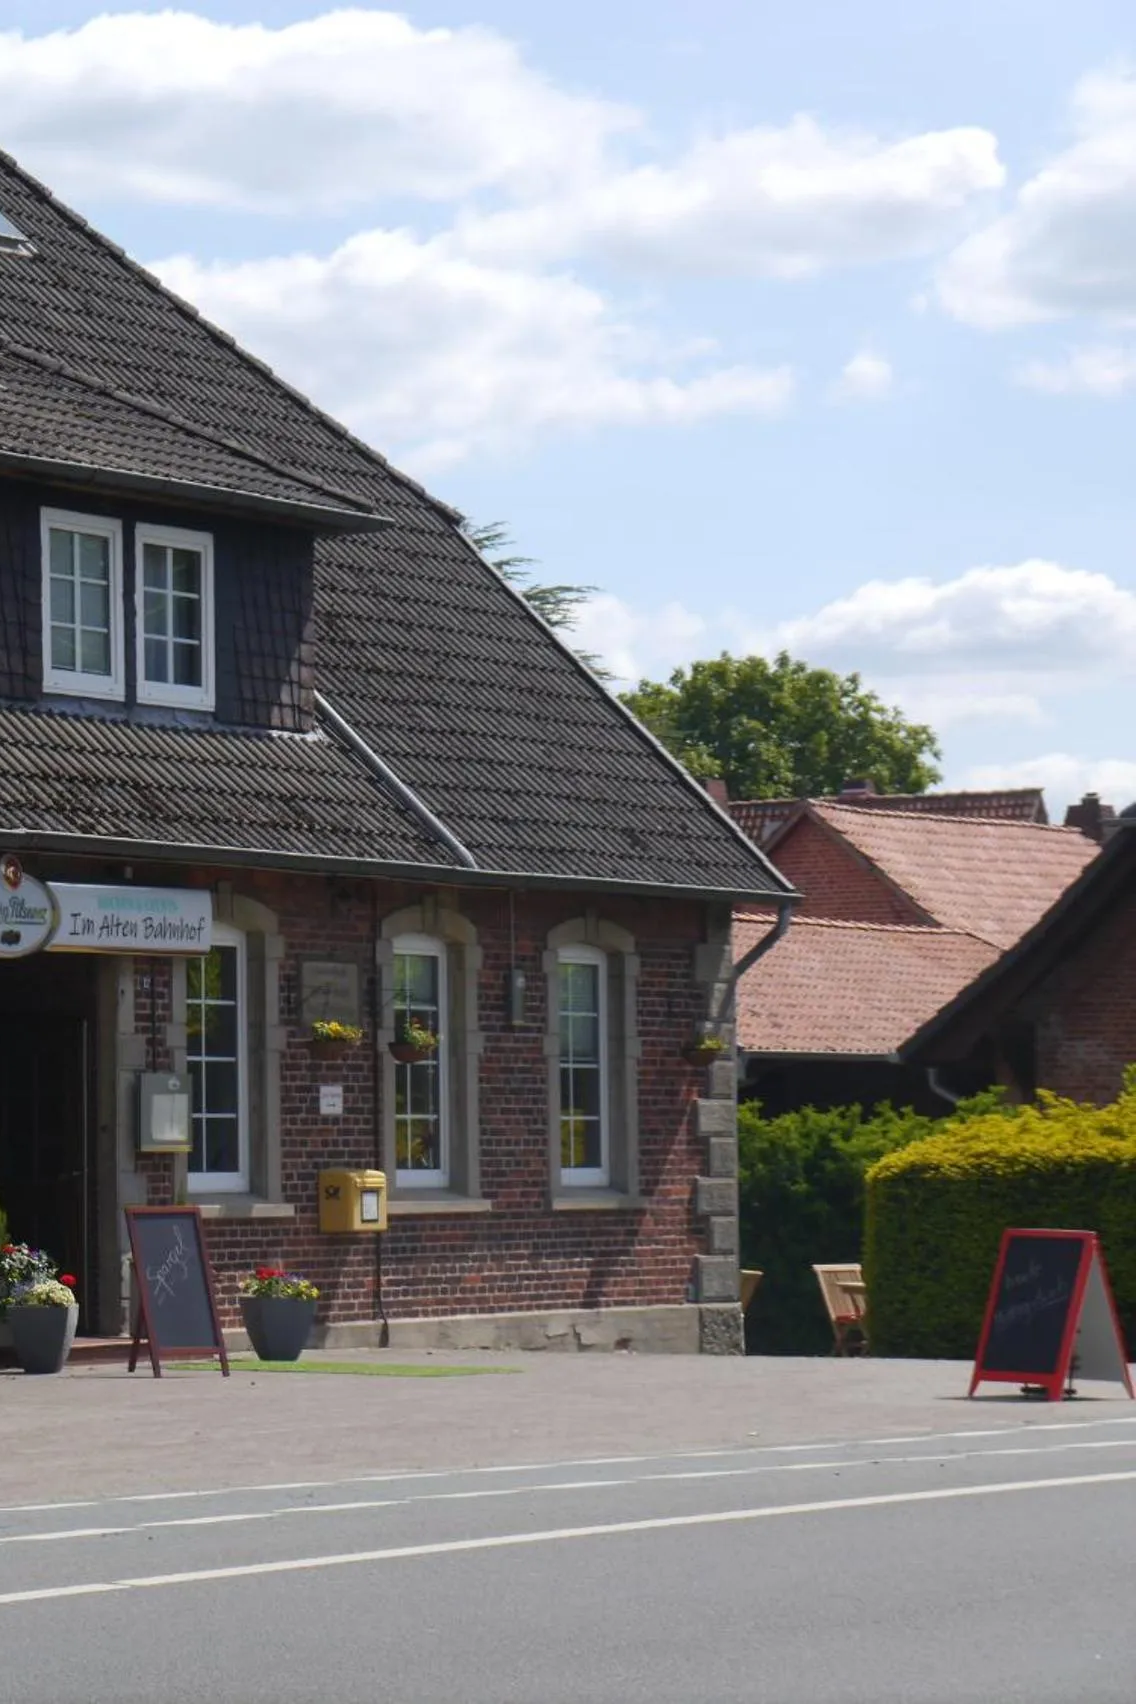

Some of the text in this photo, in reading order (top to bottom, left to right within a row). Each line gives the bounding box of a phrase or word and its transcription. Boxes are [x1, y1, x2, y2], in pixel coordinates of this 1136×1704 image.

[69, 912, 208, 943] Im Alten Bahnhof
